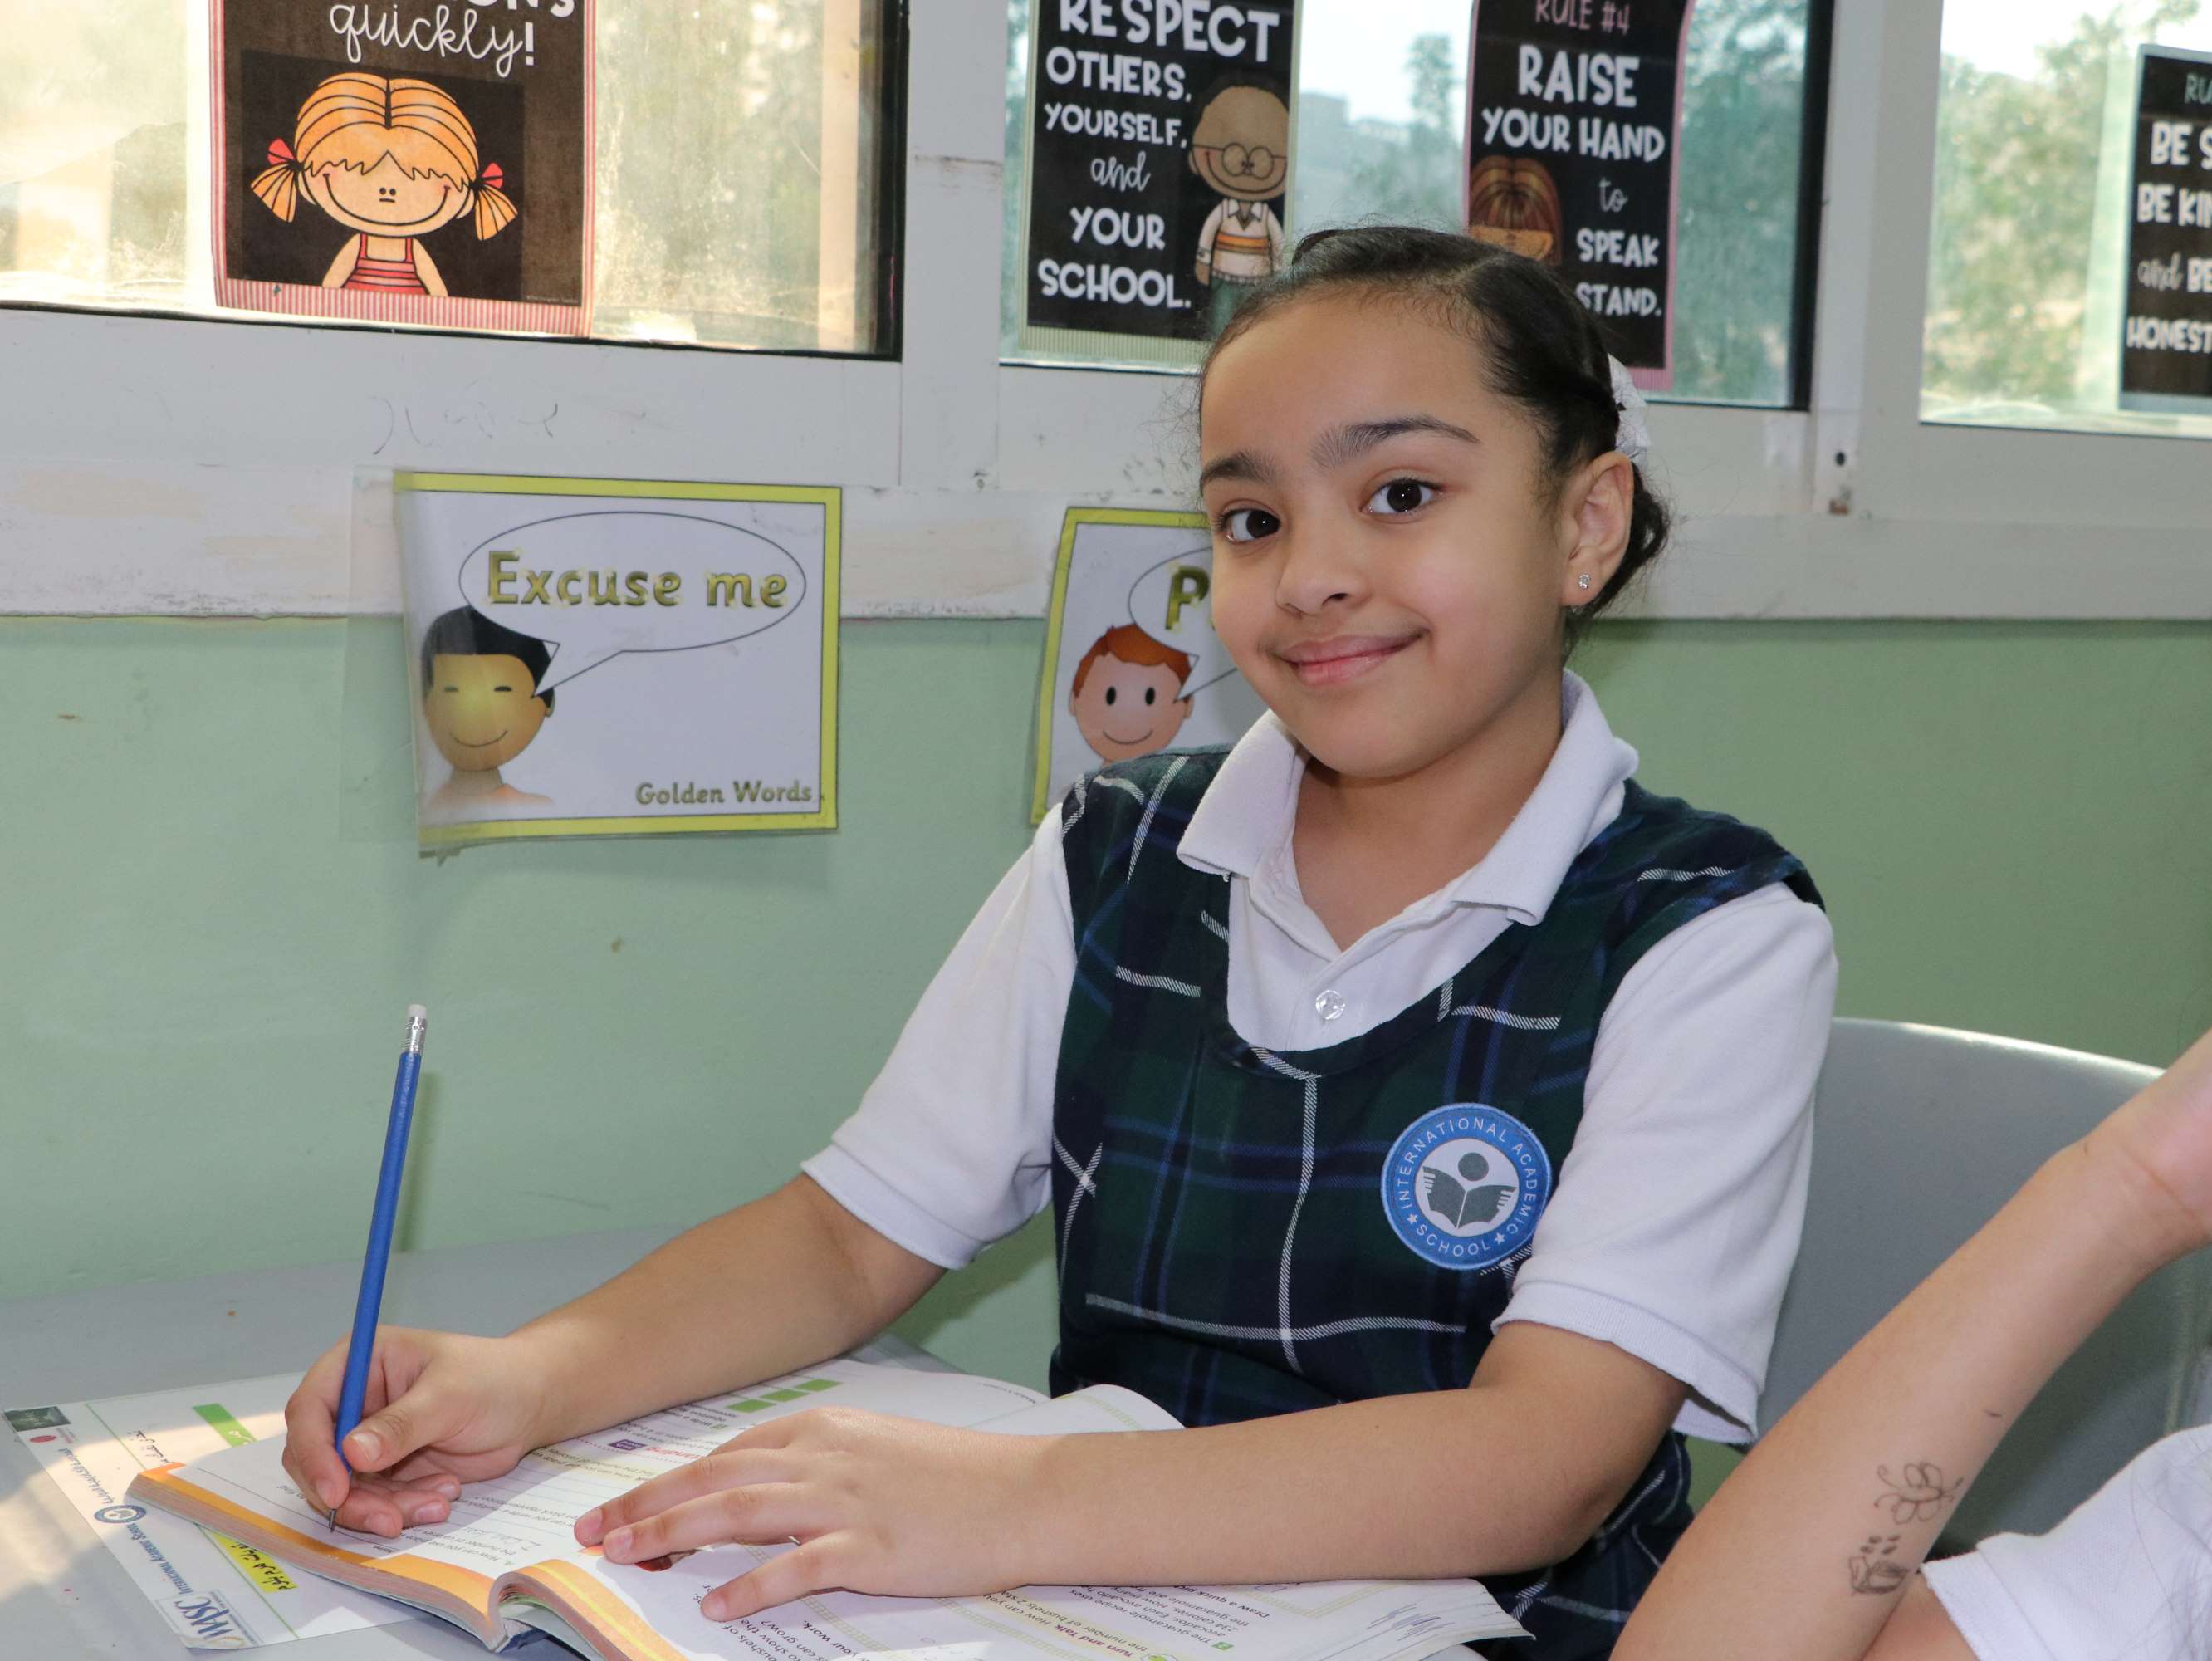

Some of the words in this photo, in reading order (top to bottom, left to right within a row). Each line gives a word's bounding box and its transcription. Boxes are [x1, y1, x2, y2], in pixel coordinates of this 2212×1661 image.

[1535, 0, 1595, 31] RULE
[1602, 3, 1631, 35] #4
[330, 4, 534, 76] quickly!
[1060, 0, 1280, 62] RESPECT
[1518, 44, 1640, 107] RAISE
[1044, 102, 1187, 149] YOURSELF,
[1481, 107, 1571, 153] YOUR
[1579, 117, 1665, 162] HAND
[2151, 122, 2193, 165] BE
[1090, 151, 1151, 192] and
[1599, 177, 1628, 213] to
[2137, 183, 2174, 223] BE
[1069, 206, 1165, 250] YOUR
[1576, 228, 1660, 267] SPEAK
[1037, 258, 1192, 308] SCHOOL.
[1575, 282, 1662, 316] STAND.
[487, 550, 683, 608] Excuse
[706, 571, 788, 609] me
[635, 782, 725, 806] Golden
[733, 781, 813, 804] Words
[1397, 1118, 1507, 1209] INTERNATIONAL
[1506, 1142, 1538, 1235] ACADEMIC
[1416, 1224, 1491, 1257] SCHOOL
[1004, 1603, 1024, 1614] can
[1169, 1597, 1230, 1619] guacamole
[1196, 1590, 1227, 1603] quick
[1025, 1613, 1051, 1625] How
[1028, 1602, 1068, 1622] bushels
[1129, 1612, 1189, 1634] guacamole
[1237, 1604, 1270, 1618] Draw
[741, 1619, 759, 1634] the
[761, 1620, 798, 1644] grow?
[803, 1619, 831, 1642] work.
[1055, 1624, 1078, 1637] Talk
[1083, 1625, 1128, 1644] number
[759, 1634, 788, 1654] show
[796, 1644, 816, 1657] can
[830, 1641, 857, 1657] your
[1077, 1634, 1105, 1645] and
[1106, 1644, 1133, 1658] Turn
[1128, 1643, 1148, 1652] the
[1191, 1634, 1211, 1644] The
